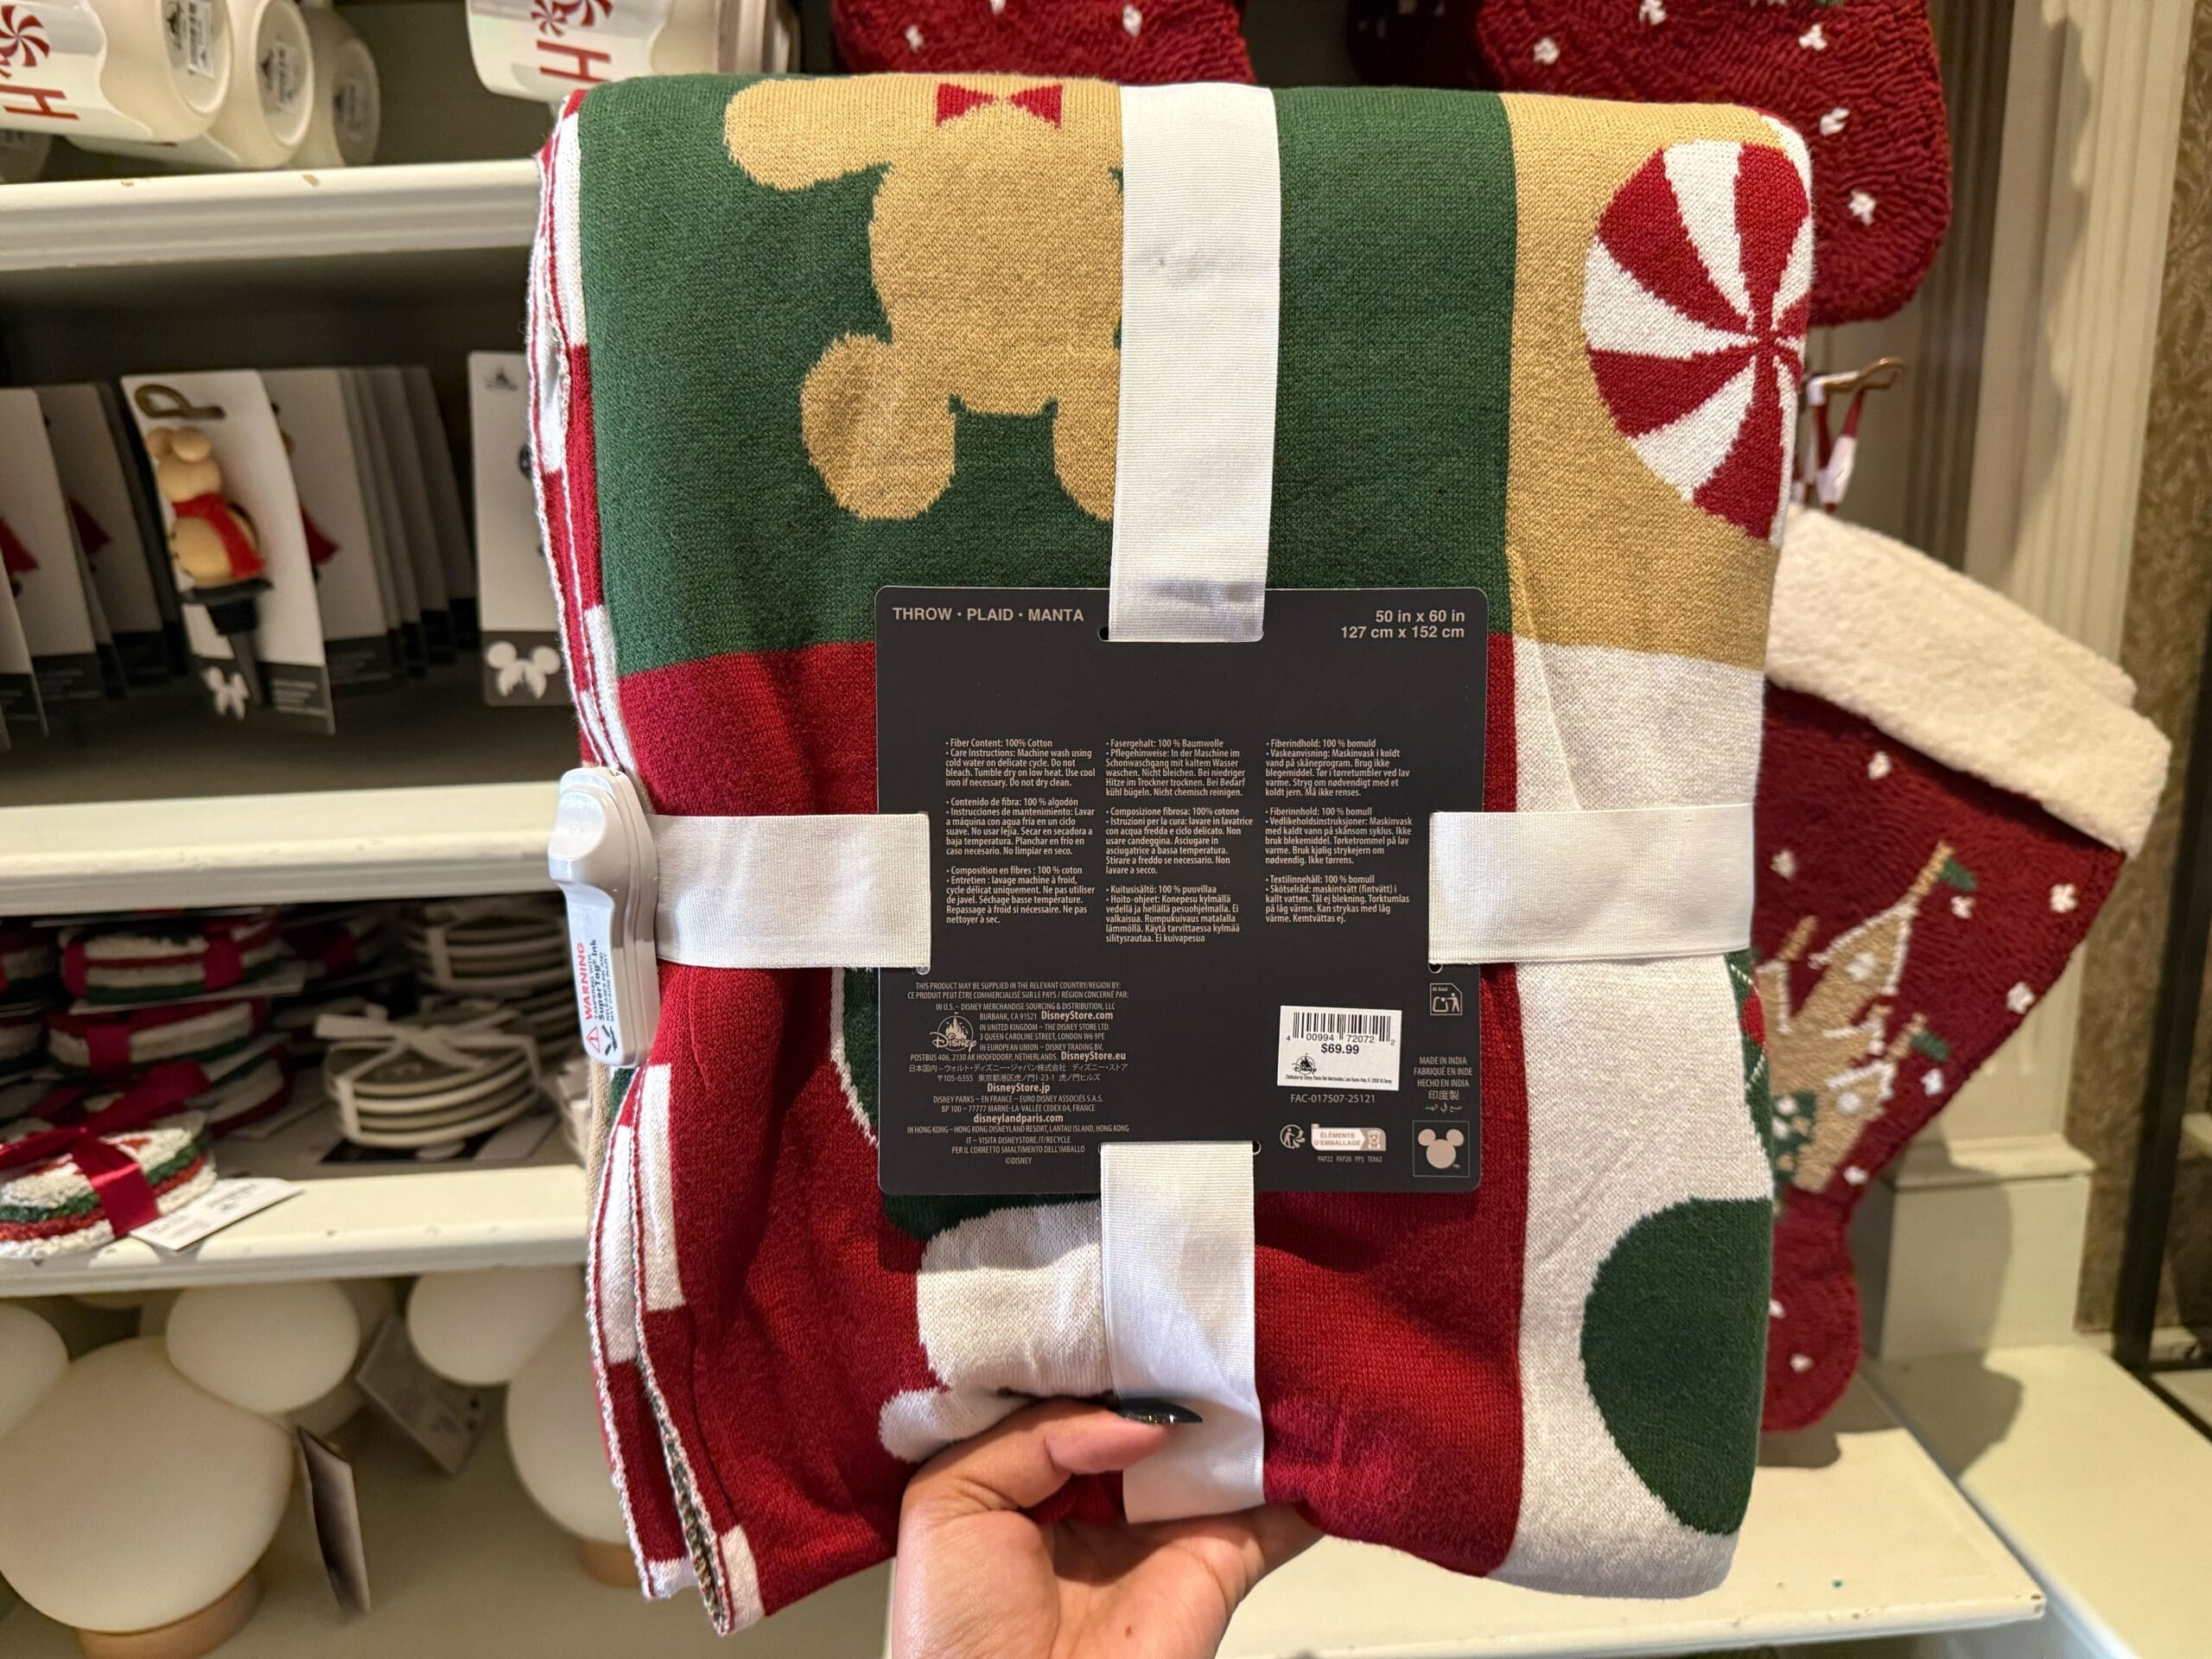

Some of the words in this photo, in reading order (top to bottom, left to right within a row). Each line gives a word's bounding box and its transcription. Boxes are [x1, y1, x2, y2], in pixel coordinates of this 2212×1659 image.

[893, 607, 952, 620] THROW
[968, 608, 1014, 621] PLAID
[1028, 608, 1084, 621] MANTA
[1376, 610, 1393, 622] 50
[1398, 610, 1411, 622] in
[1415, 613, 1424, 622] x
[1429, 610, 1446, 622] 60
[1452, 609, 1465, 622] in
[1341, 626, 1367, 638] 127
[1370, 629, 1393, 638] cm
[1398, 628, 1407, 638] x
[1412, 626, 1438, 638] 152
[1442, 628, 1465, 638] cm
[1111, 739, 1156, 750] Fasergehalt:
[1159, 739, 1172, 747] 100
[1182, 739, 1224, 747] Baumwolle
[1271, 739, 1320, 747] Fiberindhold:
[1323, 739, 1337, 747] 100
[1347, 739, 1376, 747] bomuld
[950, 748, 967, 757] Care
[969, 748, 1015, 757] Instructions:
[1017, 748, 1049, 757] Machine
[1051, 748, 1070, 757] wash
[1071, 748, 1092, 760] using
[1029, 759, 1049, 769] cycle.
[945, 768, 973, 777] bleach.
[975, 768, 1002, 777] Tumble
[1004, 768, 1016, 779] dry
[1029, 768, 1043, 777] low
[1045, 768, 1063, 777] heat.
[1065, 768, 1078, 777] Use
[1080, 768, 1096, 777] cool
[945, 778, 961, 786] iron
[963, 778, 968, 786] if
[969, 780, 1007, 789] necessary.
[1009, 778, 1020, 786] Do
[1021, 778, 1034, 786] not
[1035, 778, 1048, 789] dry
[1050, 778, 1071, 786] clean.
[950, 797, 988, 805] Contenido
[990, 797, 1000, 805] de
[1001, 797, 1021, 805] fibra:
[1024, 797, 1037, 805] 100
[1047, 797, 1078, 808] algodón
[1110, 807, 1161, 817] Composizione
[1163, 807, 1191, 816] fibrosa:
[1192, 807, 1213, 816] 100%
[1215, 807, 1239, 816] cotone
[950, 866, 997, 876] Composition
[1011, 866, 1032, 874] fibres
[1039, 866, 1051, 874] 100
[1062, 866, 1083, 874] coton
[1271, 874, 1322, 883] Textilinnehåll:
[1325, 874, 1338, 883] 100
[1348, 874, 1375, 883] bomull
[1111, 885, 1156, 893] Kuitusisältö:
[1160, 885, 1172, 893] 100
[1182, 885, 1217, 895] puuvillaa
[577, 942, 593, 1020] WARNING
[980, 1013, 1009, 1021] BURBANK,
[1041, 1011, 1113, 1021] DisneyStore.com
[1346, 1035, 1375, 1044] 72072
[1321, 1043, 1360, 1054] $69.99
[1061, 1051, 1126, 1062] DisneyStore.eu
[1414, 1066, 1445, 1077] FABRIQUÉ
[987, 1083, 1051, 1094] DisneyStore.jp
[1291, 1094, 1375, 1103] FAC-017507-25121
[1428, 1090, 1459, 1101] 印度製
[974, 1113, 1064, 1124] disneylandparis.com
